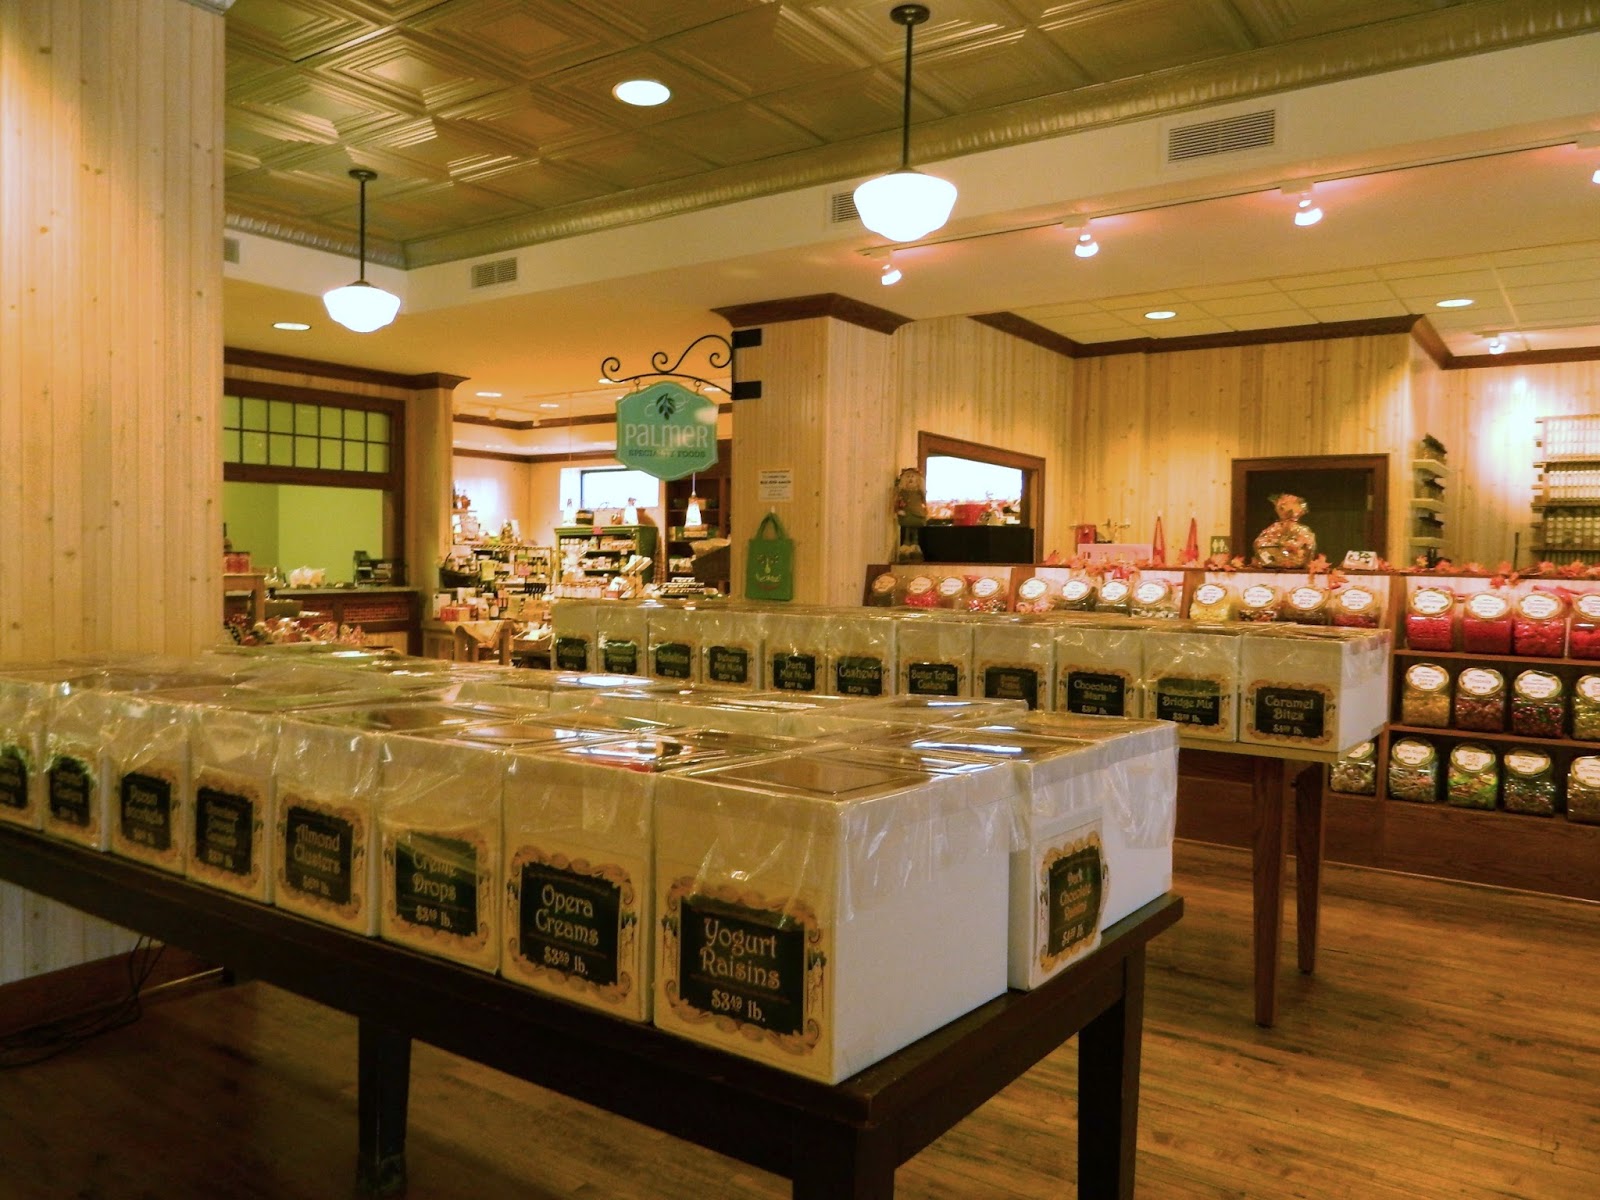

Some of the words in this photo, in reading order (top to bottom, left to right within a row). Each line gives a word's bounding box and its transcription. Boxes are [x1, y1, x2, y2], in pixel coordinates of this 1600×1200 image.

[1073, 679, 1118, 693] Chocolate
[1162, 695, 1193, 708] Bridge
[1196, 696, 1214, 710] Mix
[1265, 695, 1314, 710] Caramel
[1273, 707, 1305, 721] Bites
[296, 823, 340, 852] Almond
[293, 843, 341, 875] Clusters
[412, 872, 457, 902] Drops
[541, 883, 594, 918] Opera
[535, 907, 600, 947] Creams
[703, 917, 778, 959] Yogurt
[573, 955, 589, 975] lb.
[699, 946, 781, 990] Raisins
[747, 999, 766, 1023] lb.
